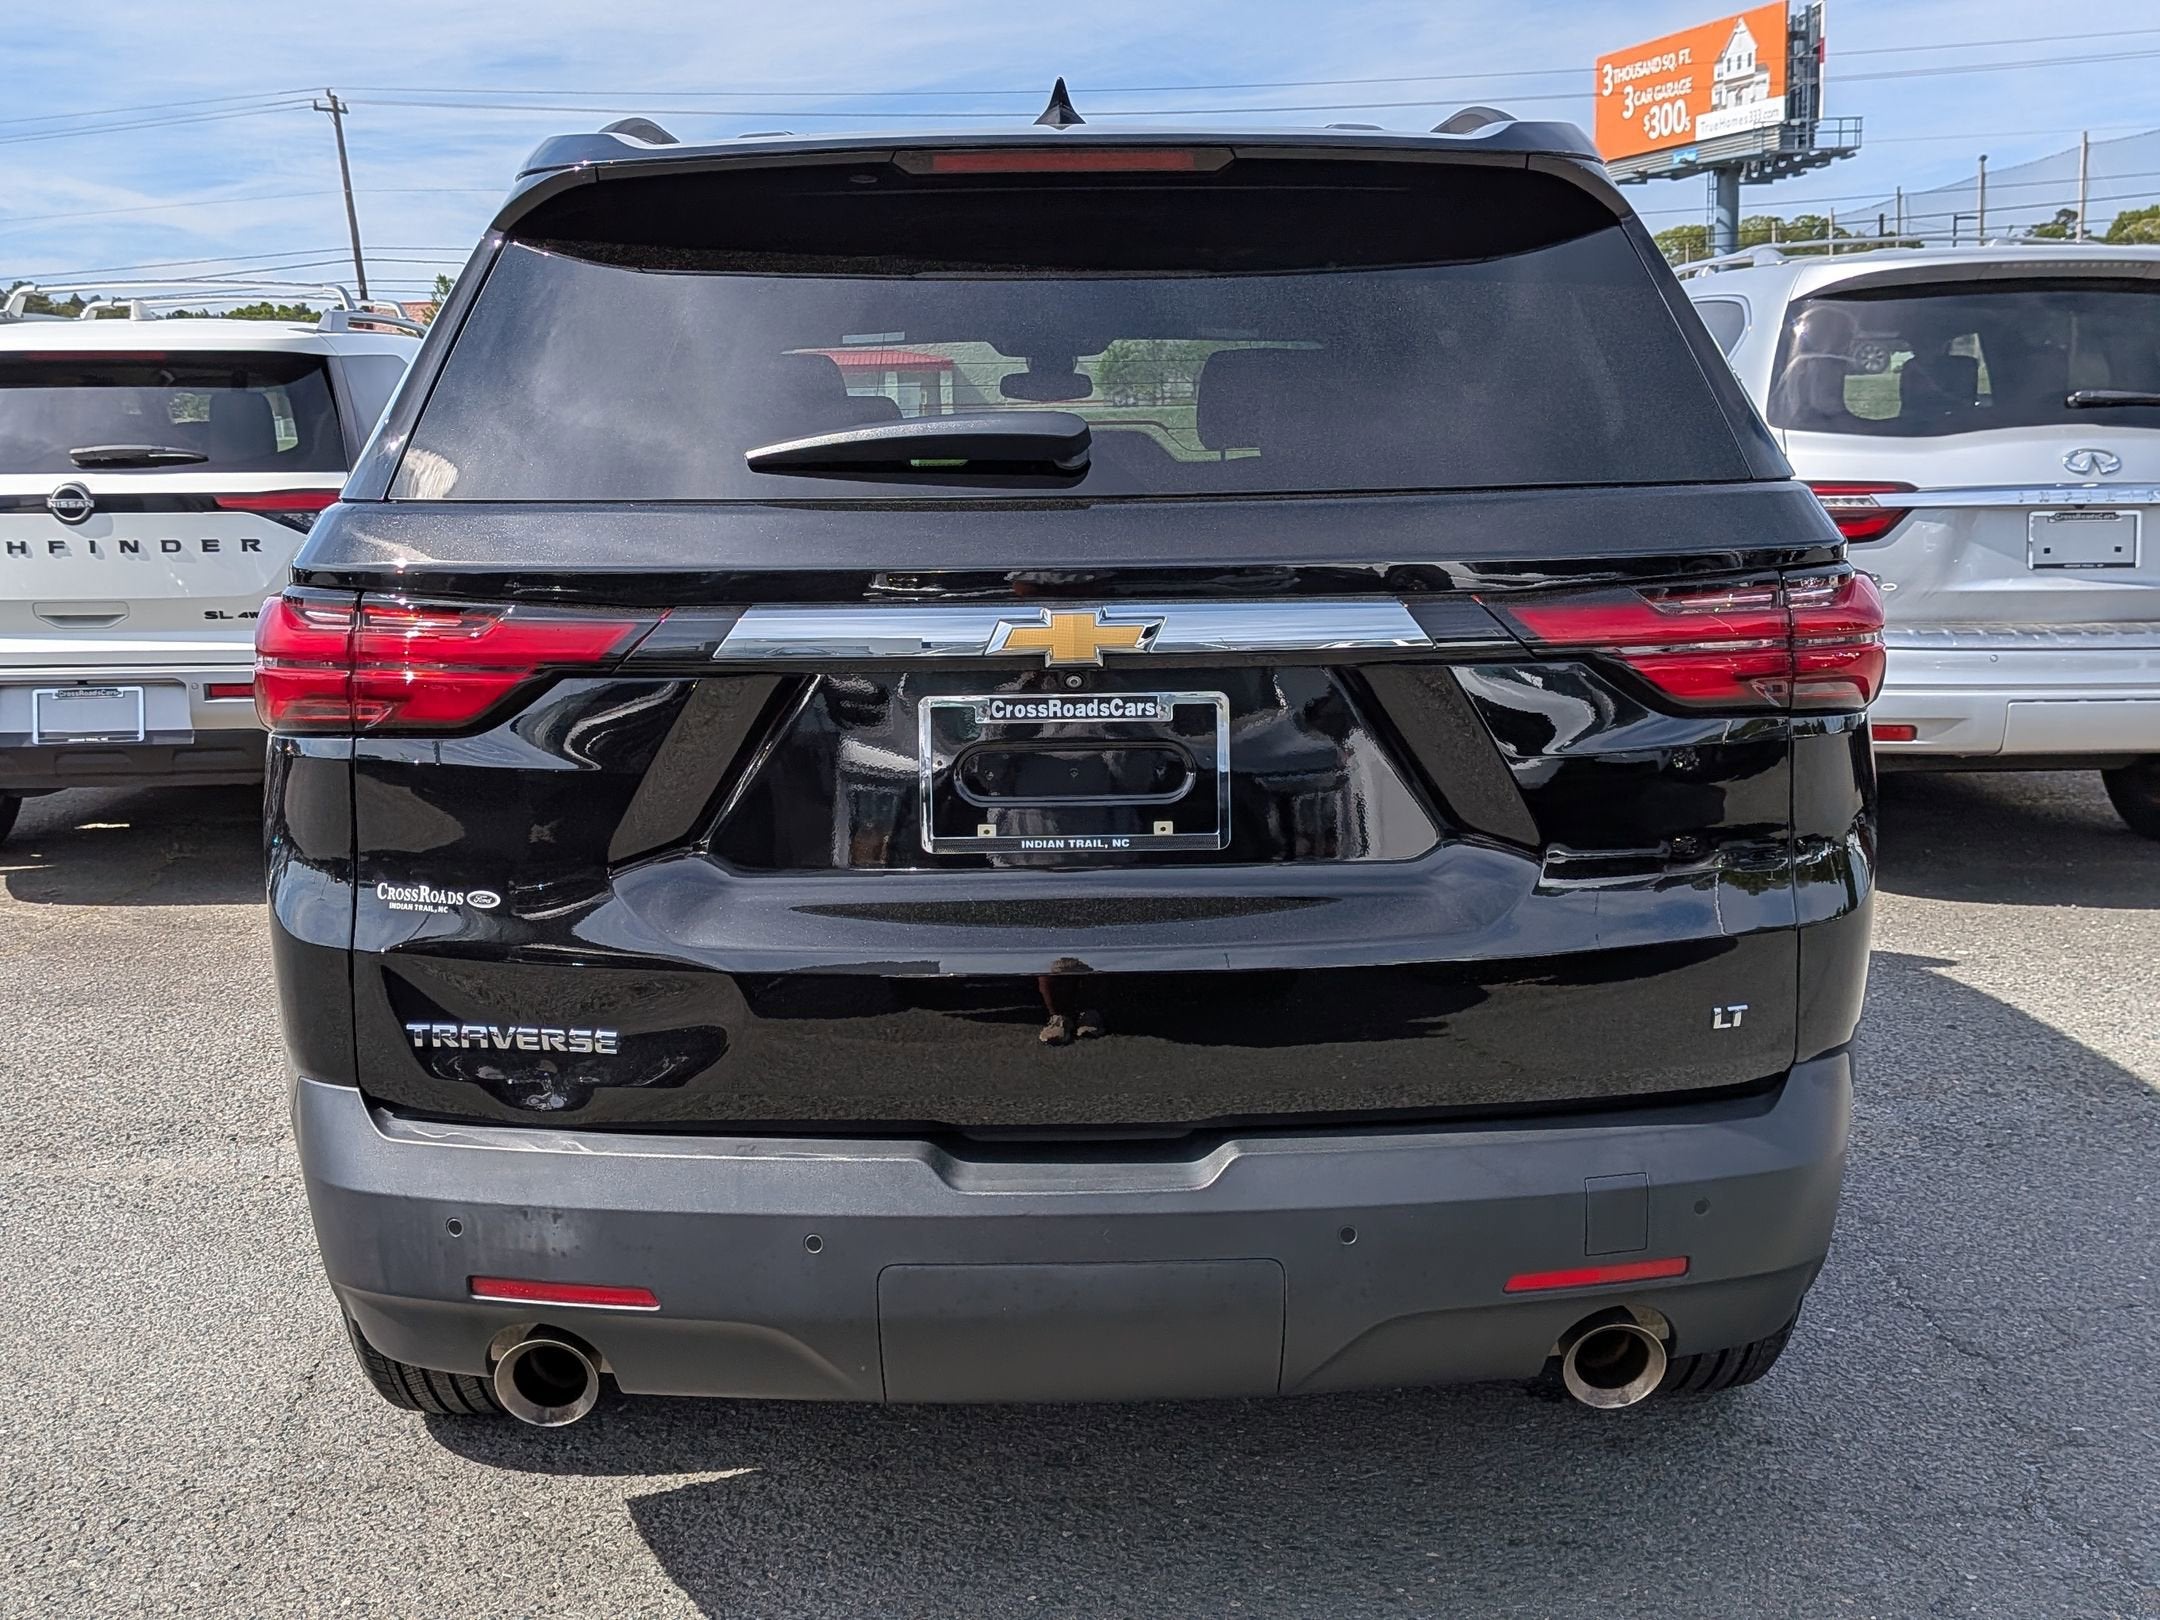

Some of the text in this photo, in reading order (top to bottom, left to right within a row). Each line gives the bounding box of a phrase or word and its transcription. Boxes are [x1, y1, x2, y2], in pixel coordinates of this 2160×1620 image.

[1602, 63, 1614, 97] 3
[1613, 56, 1662, 84] THOUSAND
[1622, 76, 1693, 119] 3 CAR GARAGE
[48, 500, 95, 509] NISSAN
[6, 538, 263, 554] HFINDER
[204, 610, 234, 620] SL
[991, 699, 1156, 719] CrossRoadsCars
[1021, 838, 1130, 850] INDIAN TRAIL, NC
[388, 902, 449, 914] INDIAN TRAIL, NC
[1713, 1004, 1748, 1029] LT
[406, 1023, 618, 1055] TRAVERSE
